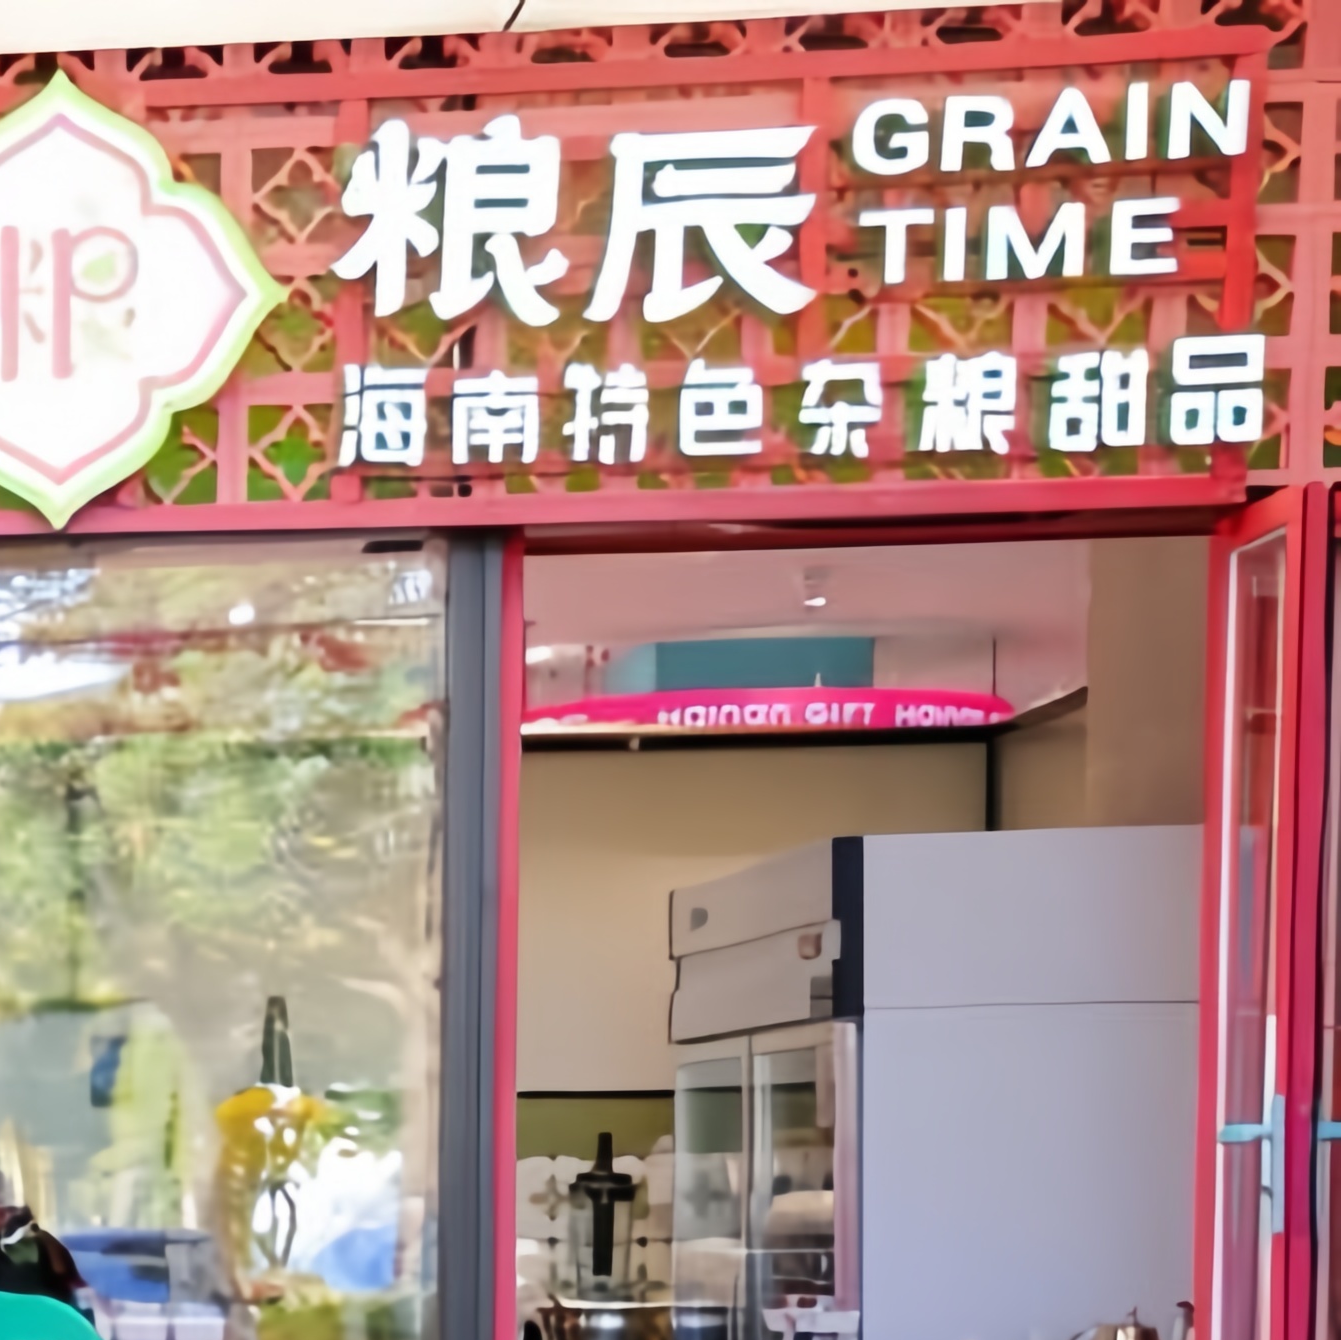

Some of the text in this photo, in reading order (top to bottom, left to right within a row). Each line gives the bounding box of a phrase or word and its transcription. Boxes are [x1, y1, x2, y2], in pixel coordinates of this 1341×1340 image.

[851, 78, 1252, 177] GRAIN
[329, 113, 819, 328] 粮辰
[858, 196, 1182, 286] TIME
[337, 333, 1267, 468] 海南特色杂粮甜品
